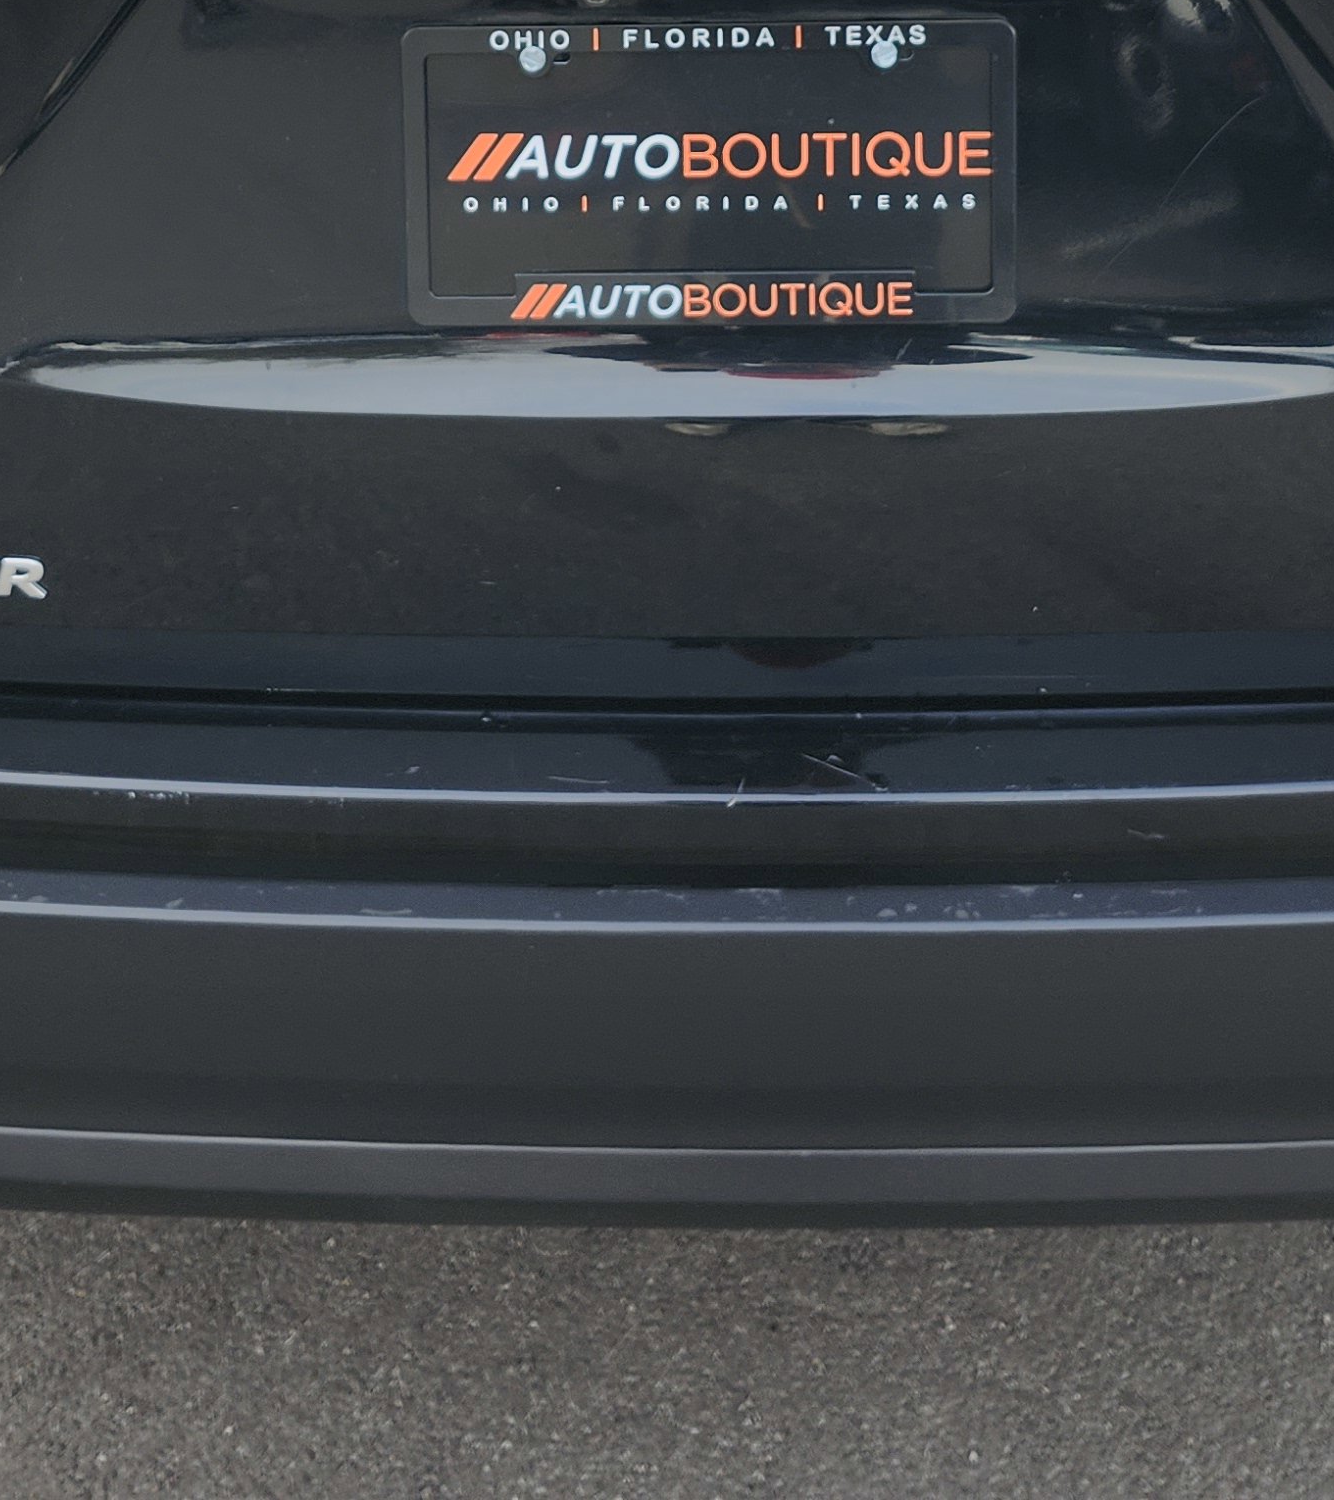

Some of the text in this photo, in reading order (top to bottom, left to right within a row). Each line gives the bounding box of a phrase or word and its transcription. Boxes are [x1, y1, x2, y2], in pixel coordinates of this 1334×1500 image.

[489, 24, 927, 51] OHIO FLORIDA TEXAS
[505, 131, 994, 179] AUTOBOUTIQUE
[463, 194, 977, 212] OHIO FLORIDA TEXAS
[553, 282, 914, 318] AUTOBOUTIQUE
